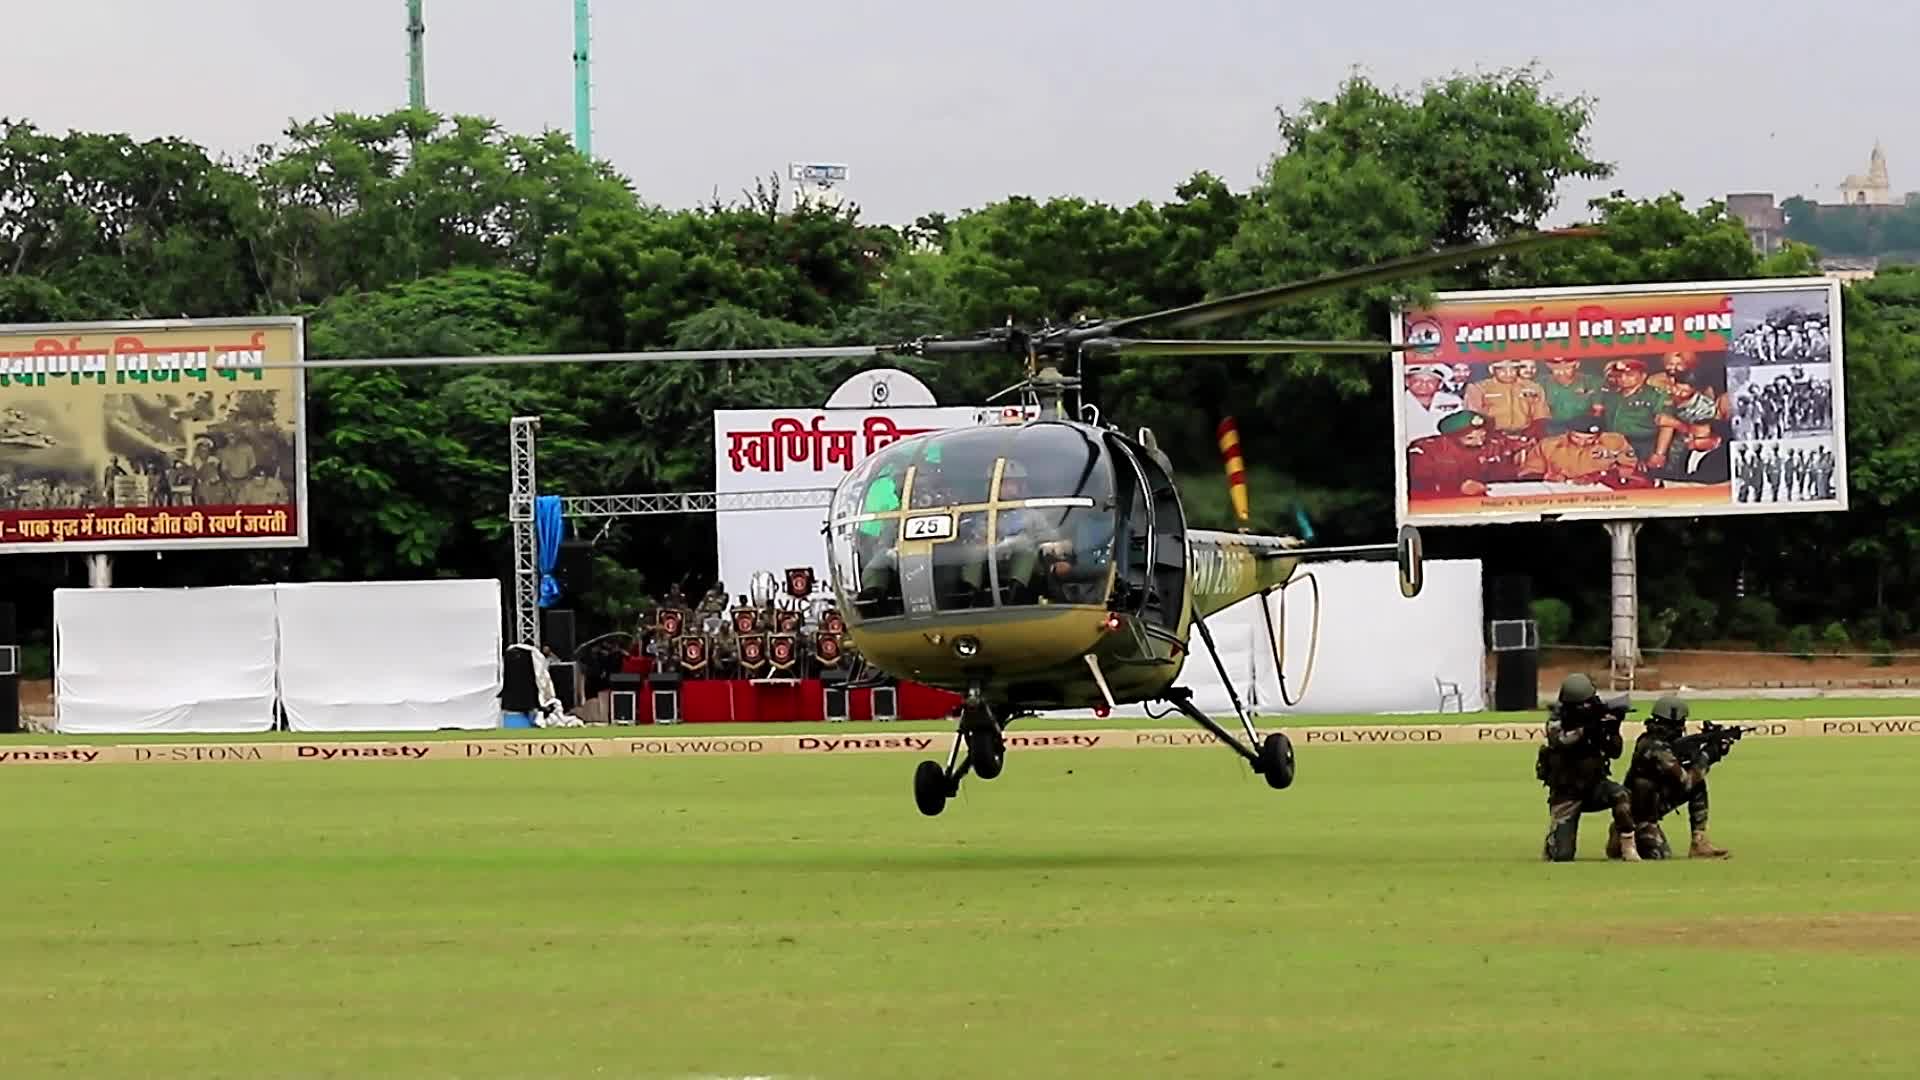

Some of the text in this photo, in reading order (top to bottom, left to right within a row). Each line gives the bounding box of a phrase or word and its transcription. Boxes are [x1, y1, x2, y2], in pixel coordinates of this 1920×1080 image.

[114, 336, 210, 385] विजय
[213, 332, 266, 381] वर्ष
[727, 416, 857, 472] स्वर्णिम
[96, 512, 149, 536] भारतीय
[150, 512, 181, 534] जीत
[183, 511, 203, 533] की
[244, 509, 287, 533] जयंती
[914, 519, 938, 534] 25
[1306, 729, 1443, 743] POLYWOOD
[465, 743, 596, 758] D-STONA
[630, 741, 764, 754] POLYWOOD
[799, 736, 933, 752] Dynasty
[134, 747, 263, 761] D-STONA
[297, 745, 429, 760] Dynasty
